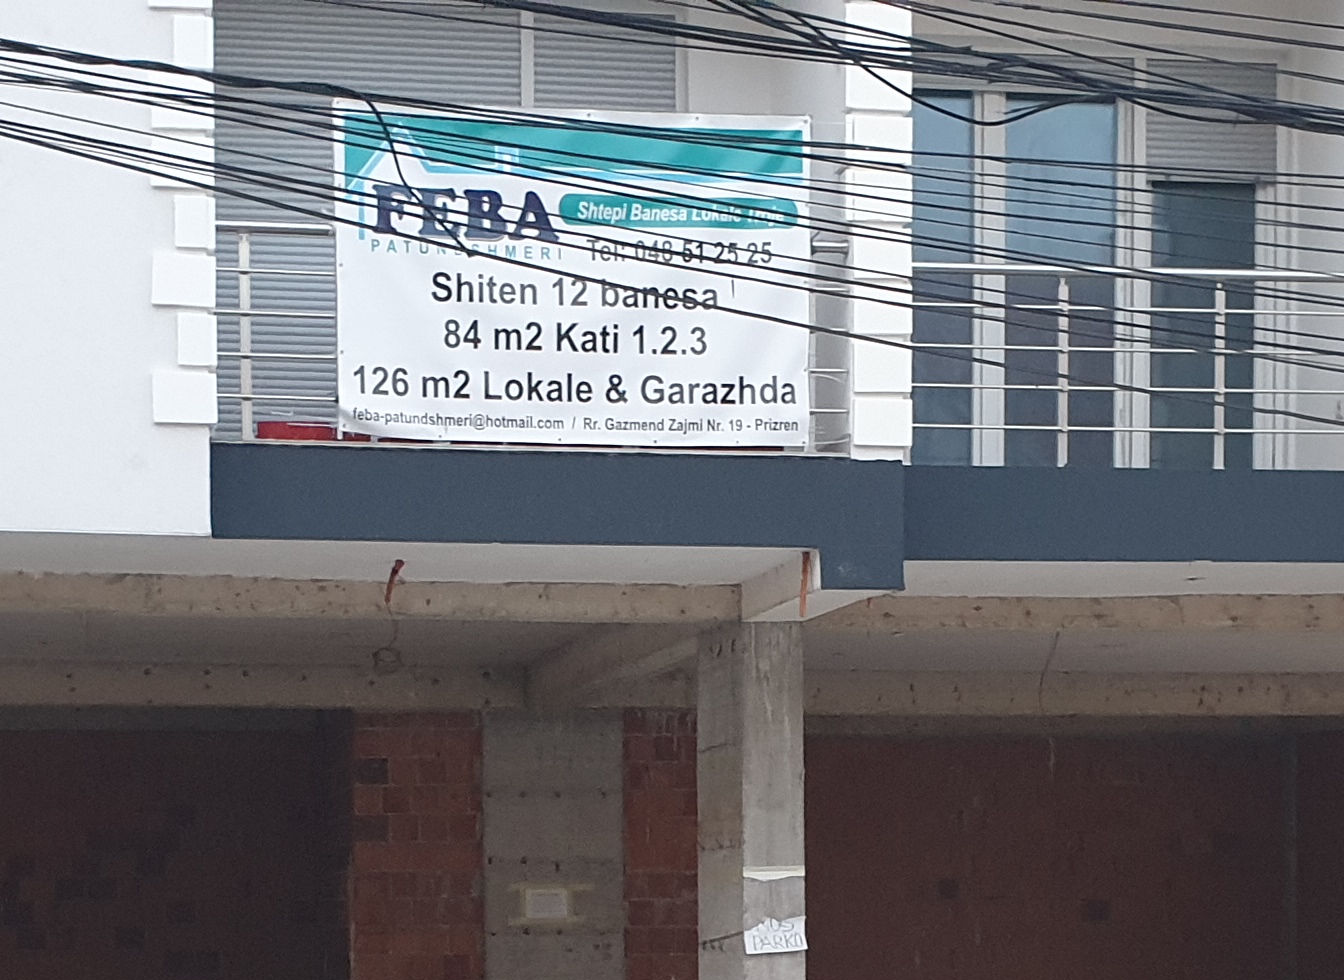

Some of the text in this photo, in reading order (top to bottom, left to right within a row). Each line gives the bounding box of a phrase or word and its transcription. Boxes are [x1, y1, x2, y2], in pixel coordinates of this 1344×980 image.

[372, 184, 560, 241] FEBA
[578, 201, 627, 223] Shtepi
[630, 203, 687, 222] Banesa
[370, 239, 562, 260] PATUNHMERI
[586, 239, 625, 262] Tel:
[634, 239, 673, 263] 048
[714, 241, 738, 264] 25
[747, 241, 772, 264] 25
[431, 271, 718, 310] Shiten 12 banesa
[443, 319, 707, 355] 84 m2 Kati 1.2.3
[353, 365, 797, 405] 126 m2 Lokale & Garazhda
[352, 407, 565, 430] feba-patundshmeri@hotmail.com
[583, 417, 601, 430] Rr.
[605, 417, 664, 431] Gazmend
[668, 418, 703, 434] Zajmi
[707, 418, 724, 431] Nr.
[729, 419, 743, 431] 19
[755, 418, 799, 431] Prizren
[752, 933, 804, 951] PARKO
